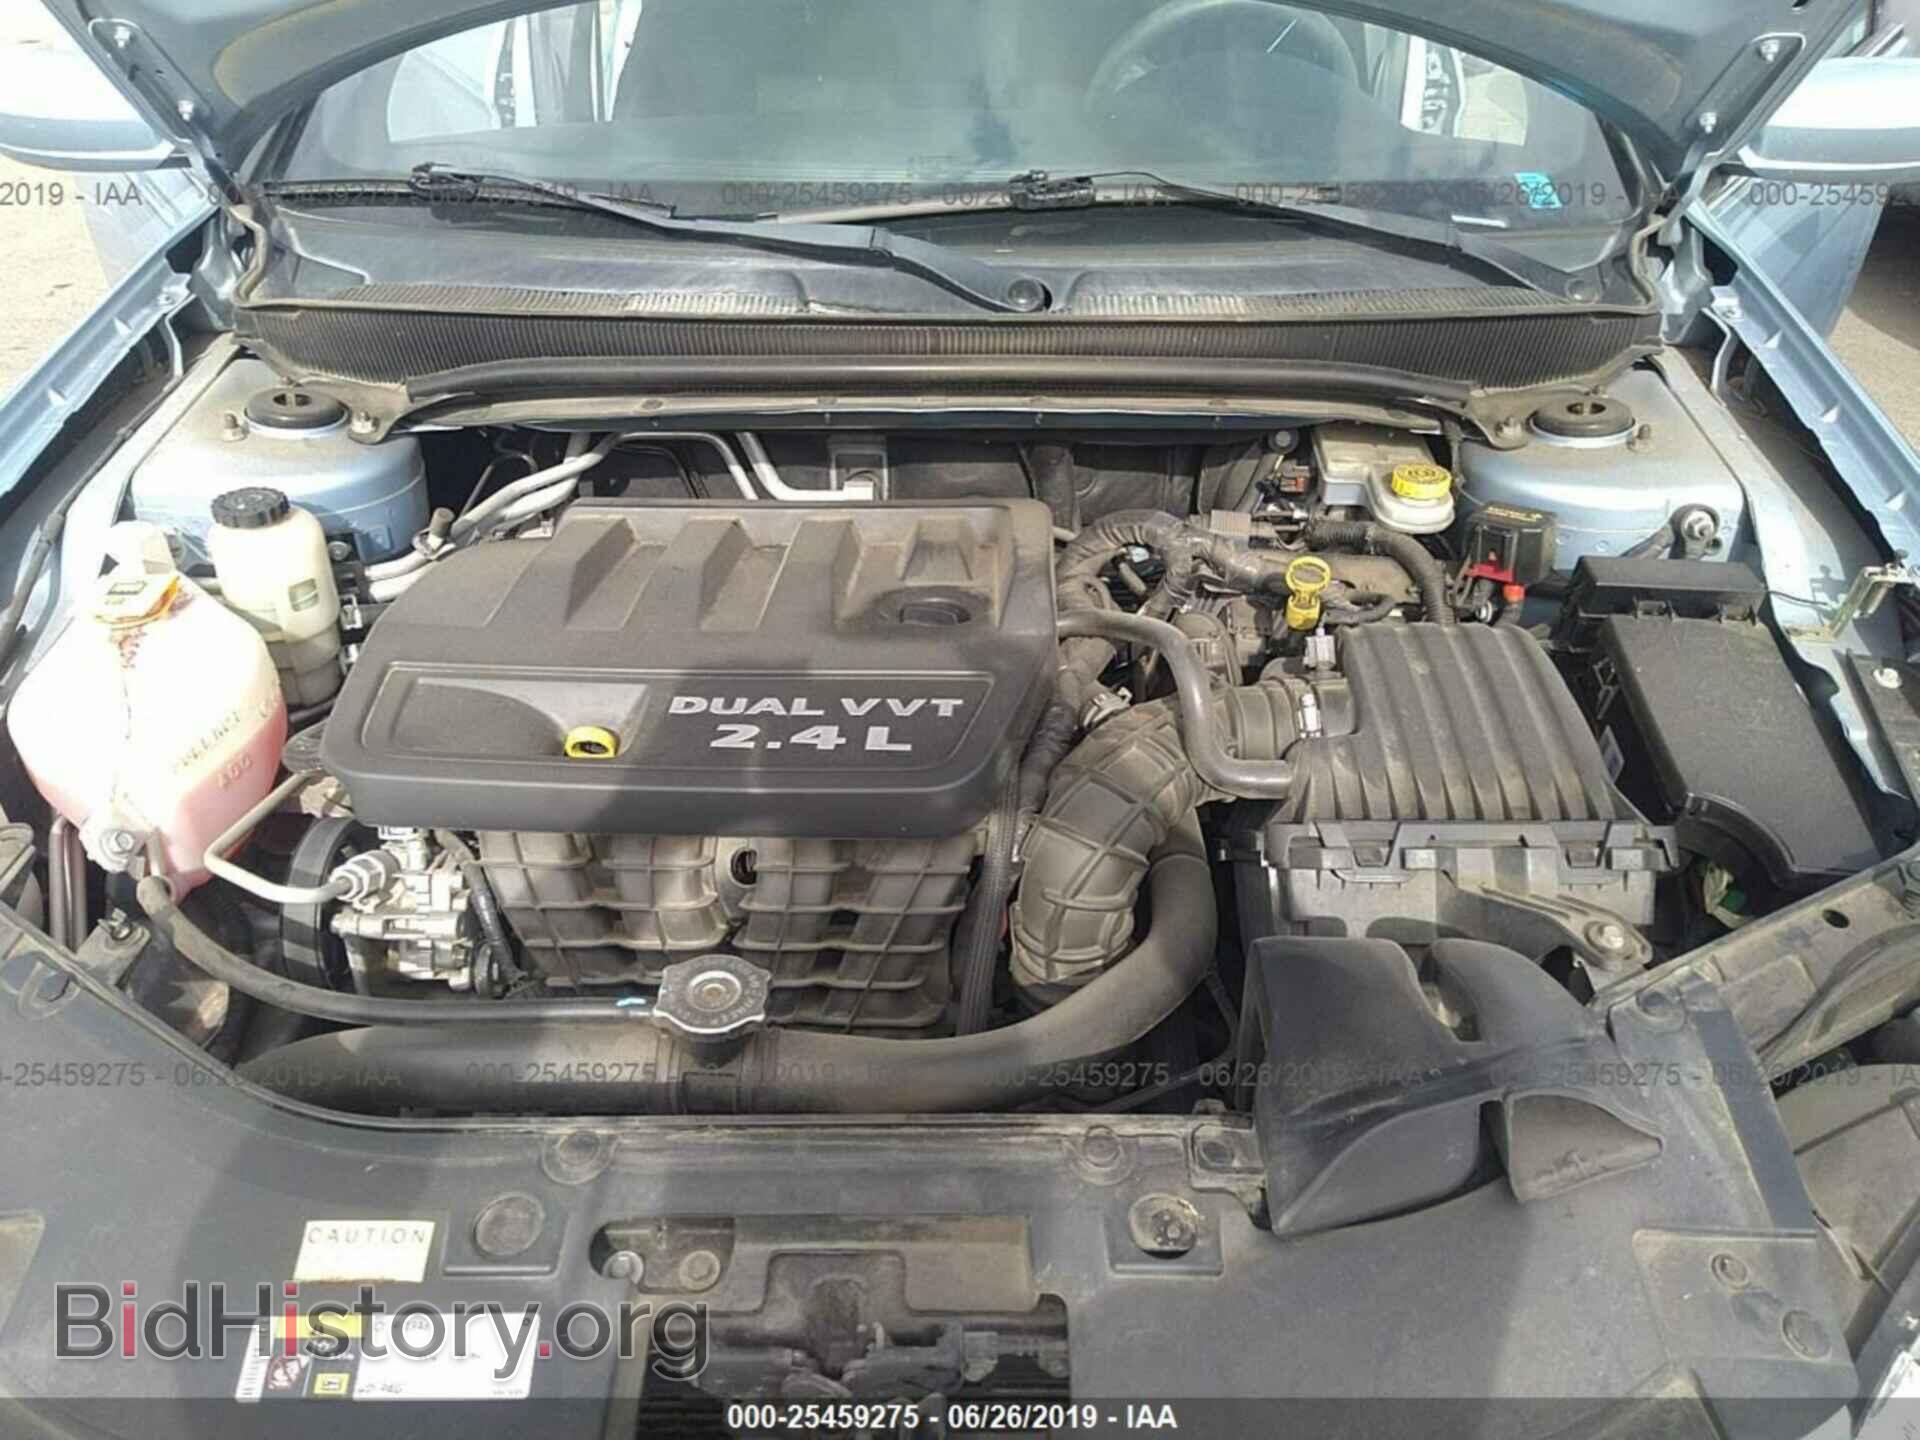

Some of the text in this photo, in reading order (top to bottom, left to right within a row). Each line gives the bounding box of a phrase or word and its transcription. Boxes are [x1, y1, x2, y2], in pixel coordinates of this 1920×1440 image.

[668, 696, 963, 716] DUAL VVT
[710, 724, 912, 751] 2.4 L
[308, 1227, 426, 1244] CAUTION
